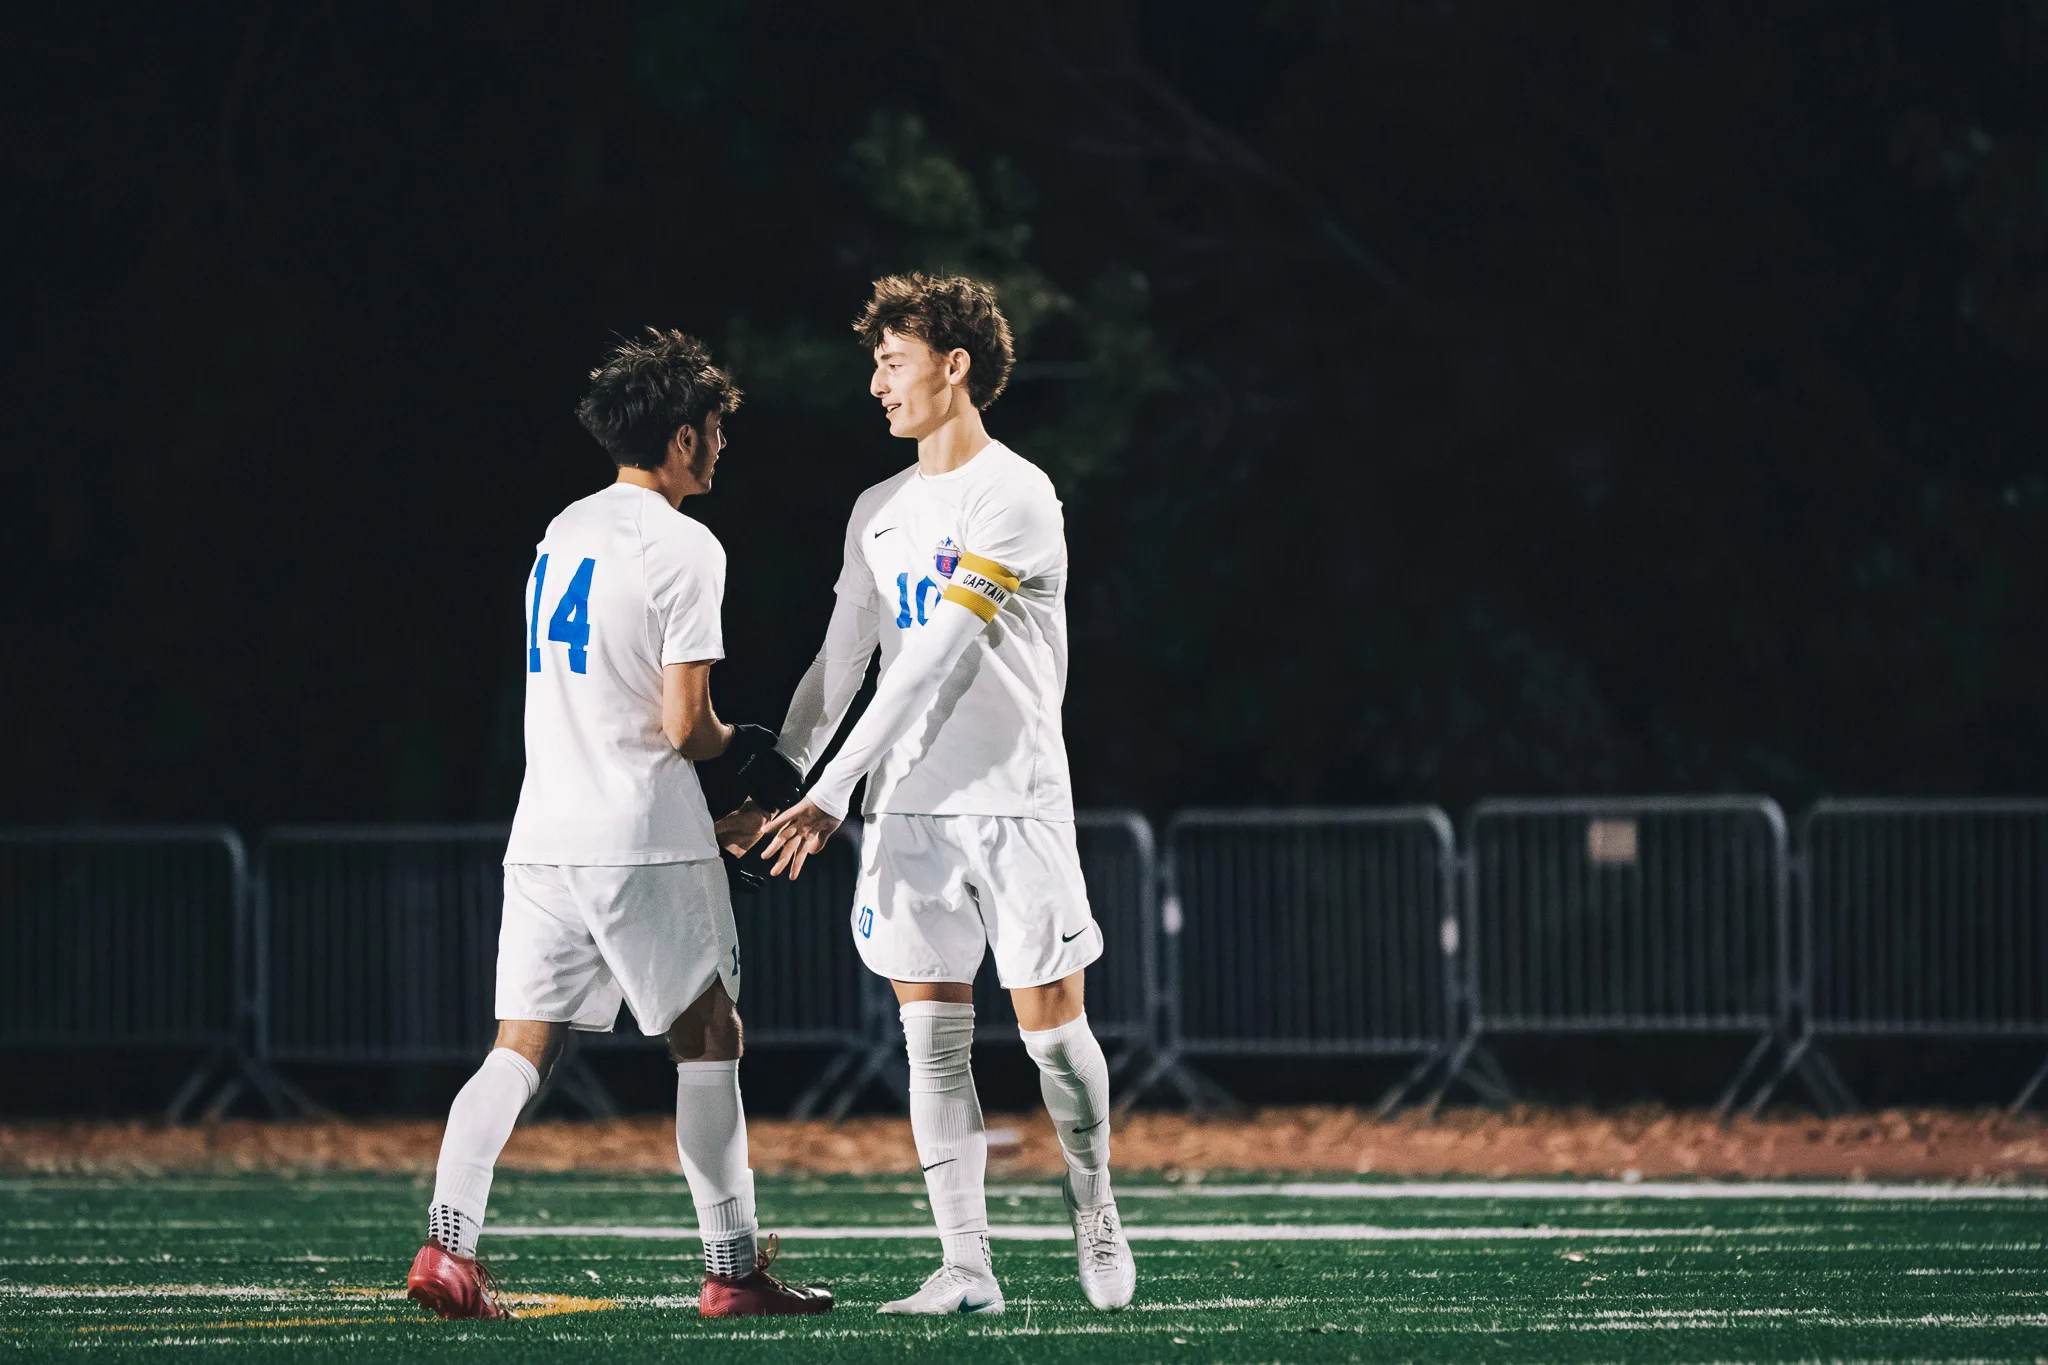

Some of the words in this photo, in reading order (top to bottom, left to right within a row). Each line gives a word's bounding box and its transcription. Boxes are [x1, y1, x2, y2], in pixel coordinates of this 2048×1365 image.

[896, 572, 942, 629] 10
[963, 574, 1006, 604] CAPTAIN
[529, 553, 596, 675] 14
[858, 905, 874, 939] 10
[731, 944, 741, 977] 1
